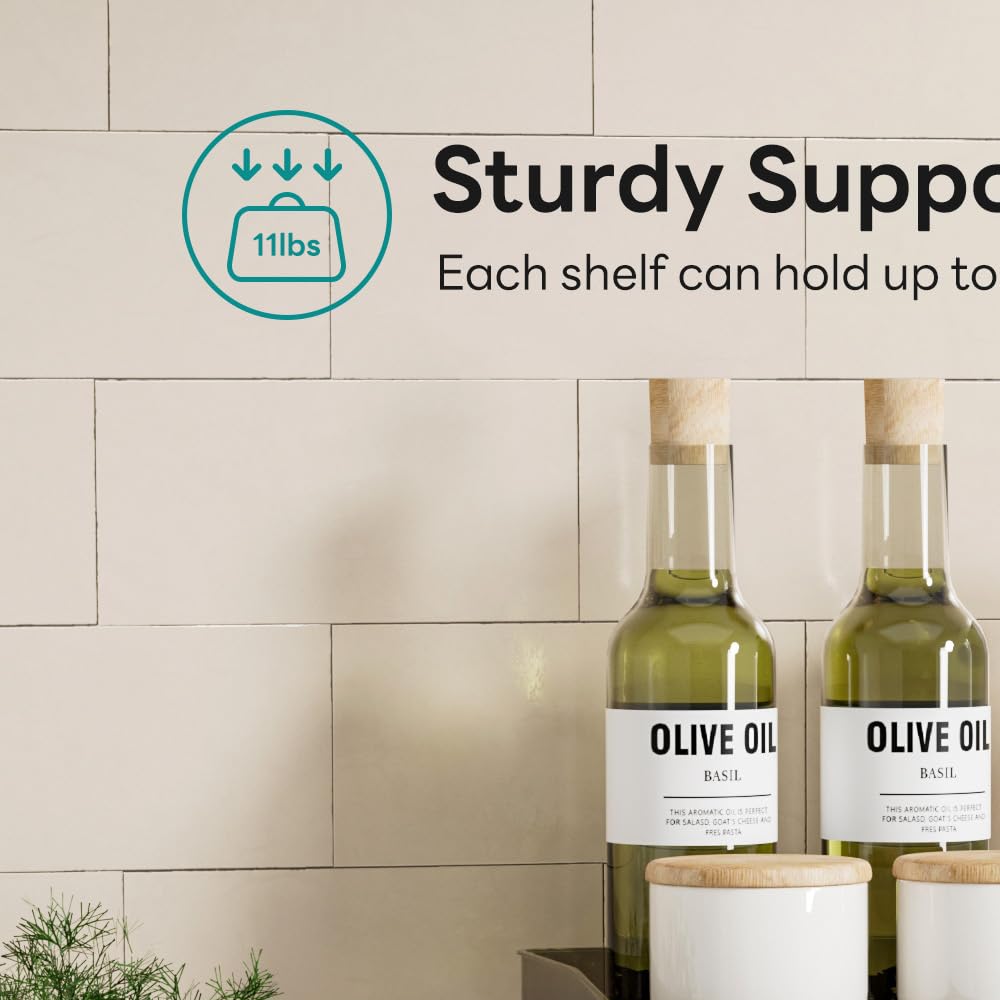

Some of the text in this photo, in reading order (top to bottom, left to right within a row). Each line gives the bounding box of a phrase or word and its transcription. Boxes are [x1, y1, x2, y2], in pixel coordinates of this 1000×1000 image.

[650, 721, 777, 756] OLIVE OIL
[867, 719, 990, 753] OLIVE OIL
[704, 769, 742, 782] BASIL
[920, 767, 957, 779] BASIL
[670, 808, 686, 816] THIS
[688, 808, 723, 816] AROMATIC
[886, 805, 902, 813] THIS
[904, 805, 938, 813] AROMATIC
[666, 818, 680, 826] FOR
[882, 815, 897, 823] FOR
